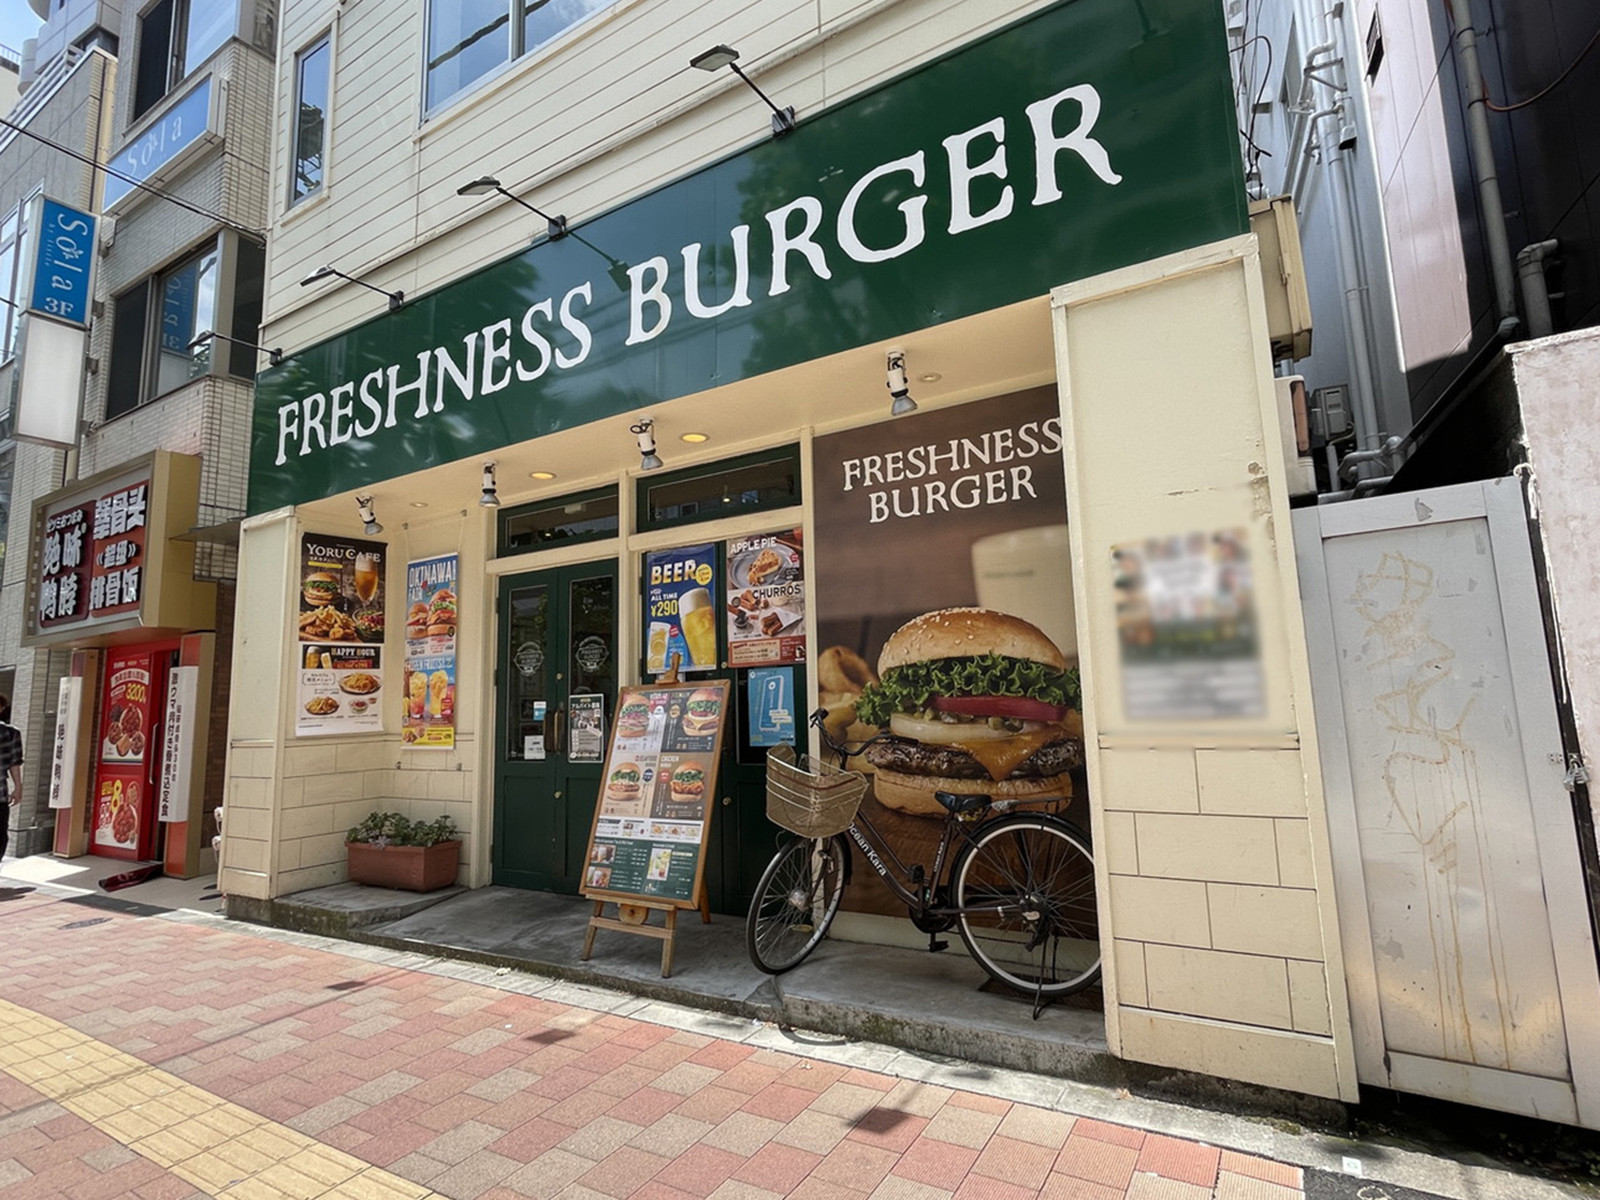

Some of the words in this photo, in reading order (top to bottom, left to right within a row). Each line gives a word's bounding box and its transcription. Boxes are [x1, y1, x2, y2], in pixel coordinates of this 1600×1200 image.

[275, 281, 592, 466] FRESHNESS
[625, 84, 1122, 346] BURGER
[44, 297, 74, 316] 3F
[842, 417, 1063, 491] FRESHNESS
[869, 465, 1037, 523] BURGER
[306, 543, 344, 559] YORU
[730, 539, 760, 554] APPLE
[761, 536, 777, 549] PIE
[650, 559, 697, 585] BEER
[650, 594, 662, 602] ALL
[663, 592, 678, 601] TIME
[752, 584, 801, 600] CHURROS
[650, 600, 678, 617] ¥290
[331, 647, 355, 656] HAPPY
[356, 648, 376, 657] HOUR
[867, 850, 886, 876] Kara
